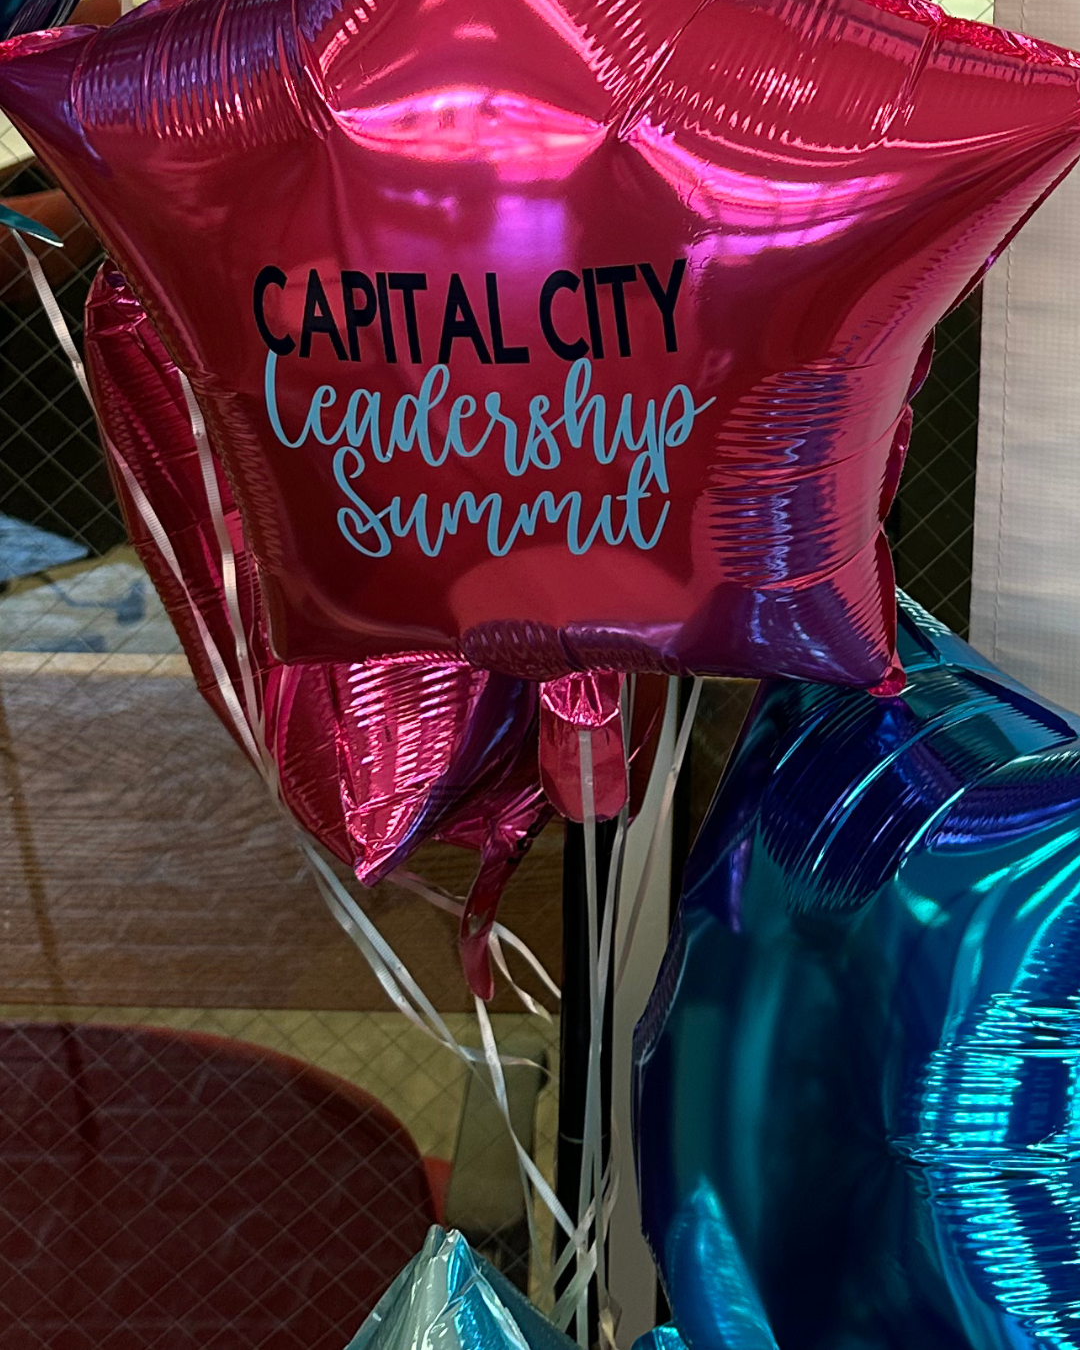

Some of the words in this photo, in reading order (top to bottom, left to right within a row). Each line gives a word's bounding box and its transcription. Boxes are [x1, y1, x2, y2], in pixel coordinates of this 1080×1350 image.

[253, 264, 530, 364] CAPITAL
[539, 258, 688, 361] CITY
[332, 445, 671, 558] Summit
